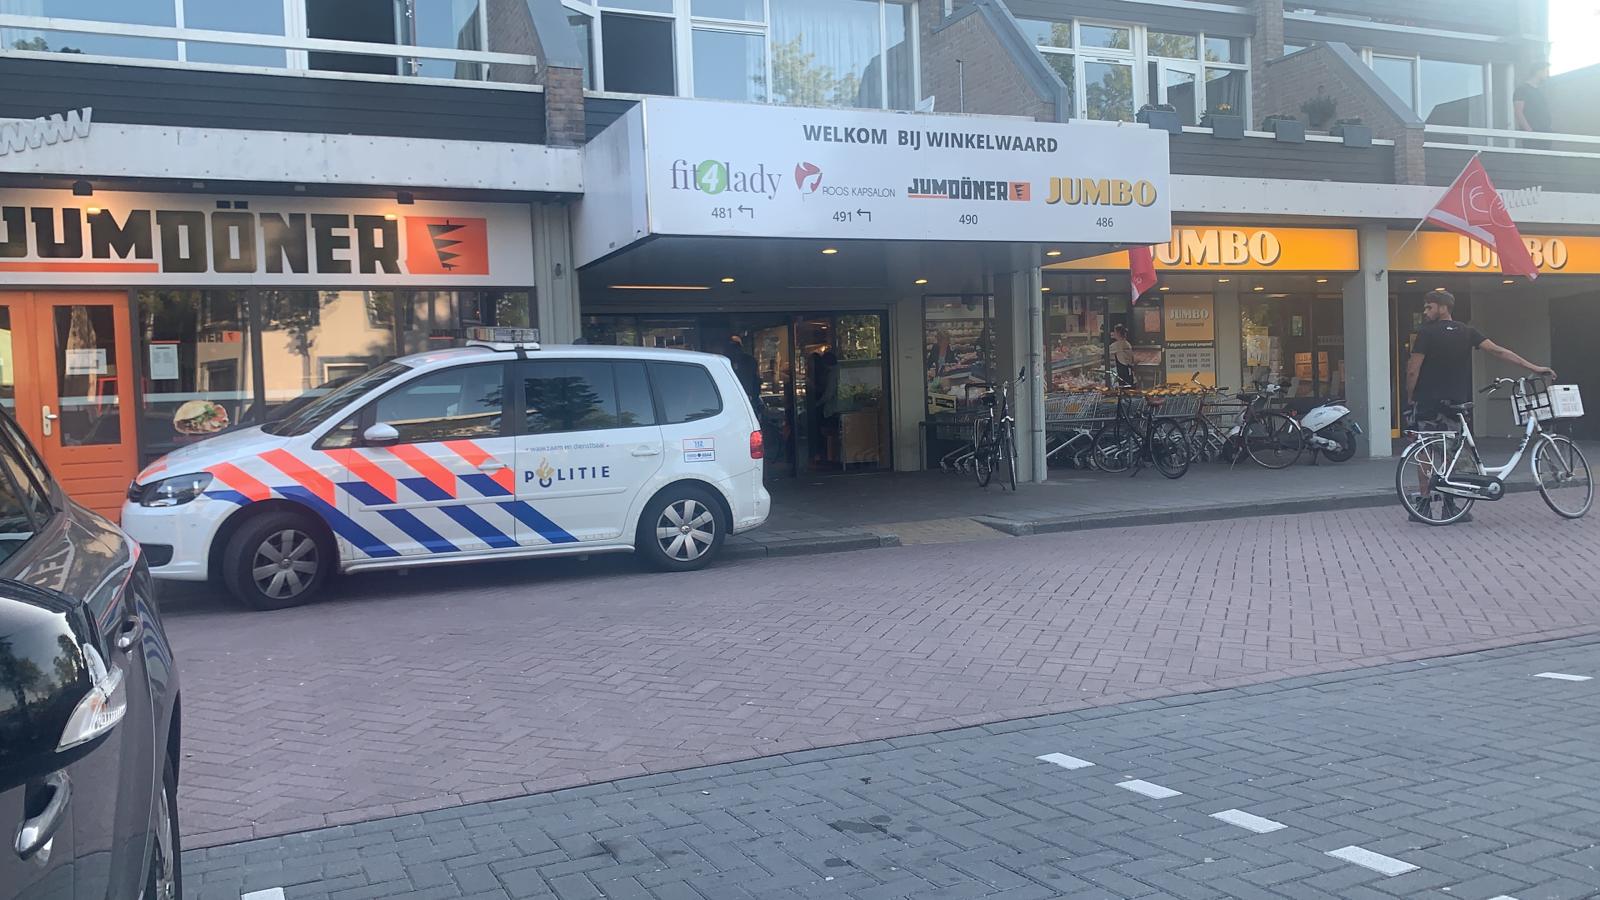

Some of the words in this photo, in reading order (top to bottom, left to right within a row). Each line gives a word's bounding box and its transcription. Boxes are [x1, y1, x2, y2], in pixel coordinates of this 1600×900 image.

[802, 124, 888, 145] WELKOM
[898, 129, 922, 151] BIJ
[927, 132, 1058, 153] WINKELWAARD
[669, 159, 782, 200] fit4lady
[907, 177, 1009, 201] JUMDÖNER
[822, 186, 850, 196] ROOS
[851, 187, 896, 198] KAPSALON
[1046, 177, 1157, 207] JUMBO
[711, 207, 732, 219] 481
[832, 211, 852, 223] 491
[959, 214, 978, 225] 490
[1096, 217, 1114, 228] 486
[1149, 229, 1282, 266] UMBO
[1454, 234, 1568, 270] JUBO
[524, 465, 610, 488] POLITIE
